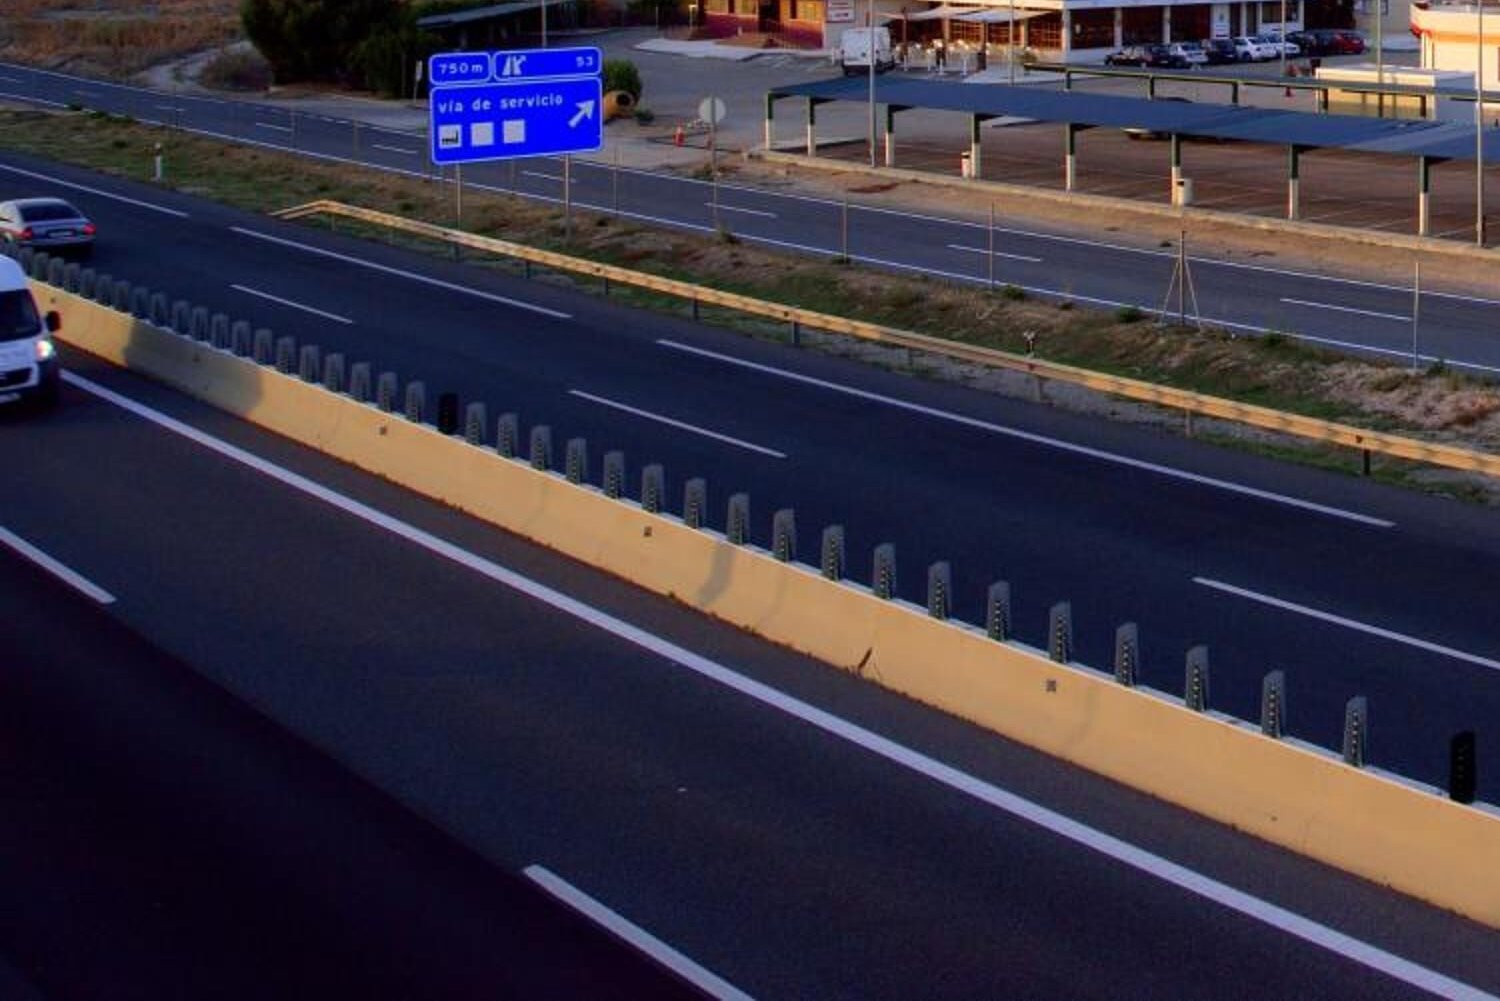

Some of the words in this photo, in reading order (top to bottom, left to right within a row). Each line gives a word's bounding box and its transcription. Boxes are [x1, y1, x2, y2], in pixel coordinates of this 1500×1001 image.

[438, 62, 469, 75] 750
[471, 63, 484, 73] m
[471, 97, 491, 112] de
[500, 93, 564, 110] servicio
